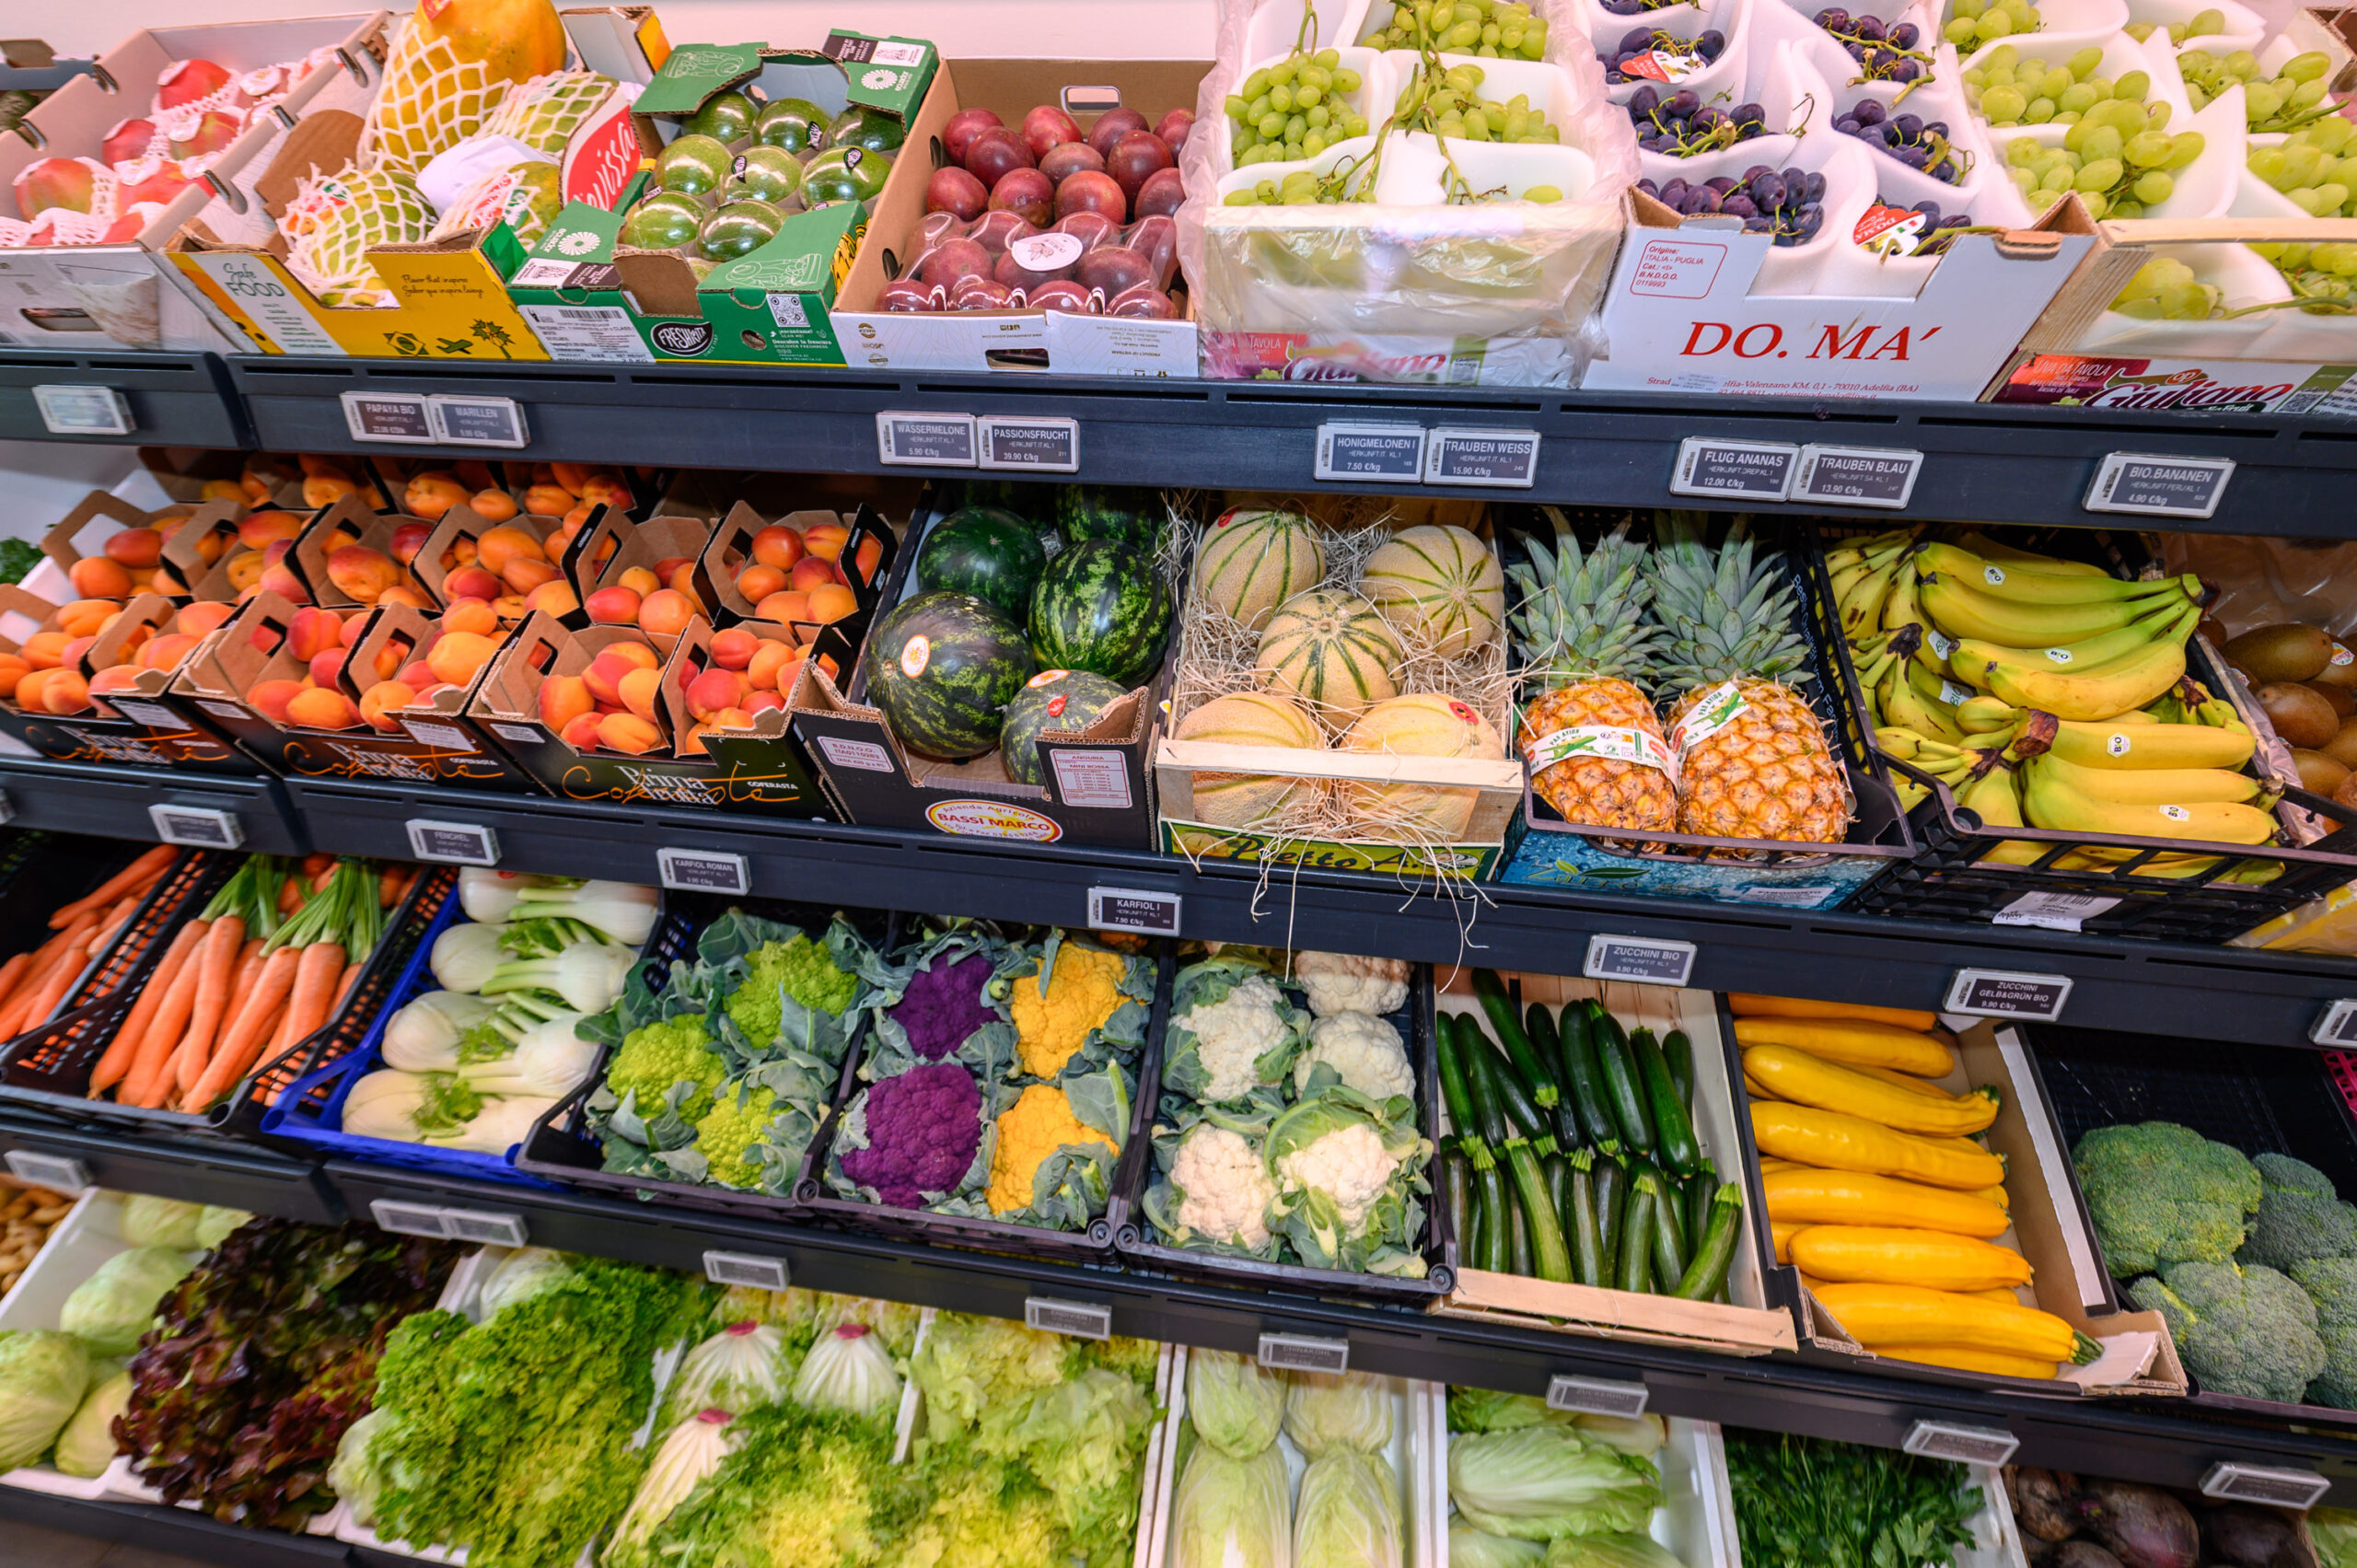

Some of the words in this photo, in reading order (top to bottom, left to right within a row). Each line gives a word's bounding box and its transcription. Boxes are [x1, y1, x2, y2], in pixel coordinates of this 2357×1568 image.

[1675, 256, 1704, 264] PUGLIA
[225, 282, 285, 296] FOOD
[1679, 321, 1788, 359] DO.
[2072, 361, 2112, 377] TAVOLA
[1861, 383, 1894, 391] Adelfia
[1896, 384, 1920, 392] (BA)
[2081, 378, 2294, 408] Giuliano
[366, 403, 400, 413] PAPAYA
[401, 404, 415, 415] BIO
[455, 407, 498, 418] MARILLEN
[897, 424, 966, 436] WASSERMELONE
[994, 428, 1069, 440] PASSIONSFRUCHT
[1338, 437, 1411, 449] HONIGMELONEN
[1445, 440, 1497, 453] TRAUBEN
[1497, 442, 1532, 455] WEISS
[924, 447, 940, 458] €/kg
[1004, 452, 1022, 461] 39.90
[1024, 453, 1039, 462] €/kg
[1705, 451, 1736, 464] FLUG
[1736, 454, 1783, 467] ANANAS
[1364, 462, 1381, 473] €/kg
[1453, 466, 1472, 475] 15.90
[1474, 467, 1492, 477] €/kg
[1820, 457, 1877, 472] TRAUBEN
[1878, 461, 1908, 474] BLAU
[2129, 466, 2212, 482] BIO.BANANEN
[1703, 477, 1724, 487] 12.00
[1726, 478, 1745, 490] €/kg
[1821, 484, 1843, 494] 13.90
[1844, 485, 1863, 496] €/kg
[2129, 494, 2146, 504] 4.90
[2148, 494, 2167, 506] €/kg
[747, 781, 799, 790] COFERASTA
[937, 813, 984, 825] BASSI
[989, 819, 1051, 831] MARCO
[675, 859, 706, 869] KARFIOL
[1117, 899, 1155, 911] KARFIOL
[1129, 918, 1144, 926] €/kg
[1613, 947, 1660, 958] ZUCCHINI
[1662, 951, 1680, 960] BIO
[1632, 967, 1648, 976] €/kg
[1997, 981, 2038, 992] ZUCCHINI
[1979, 989, 2033, 1001] GELB&GRÜN
[2033, 994, 2049, 1003] BIO
[1999, 1001, 2016, 1011] €/kg
